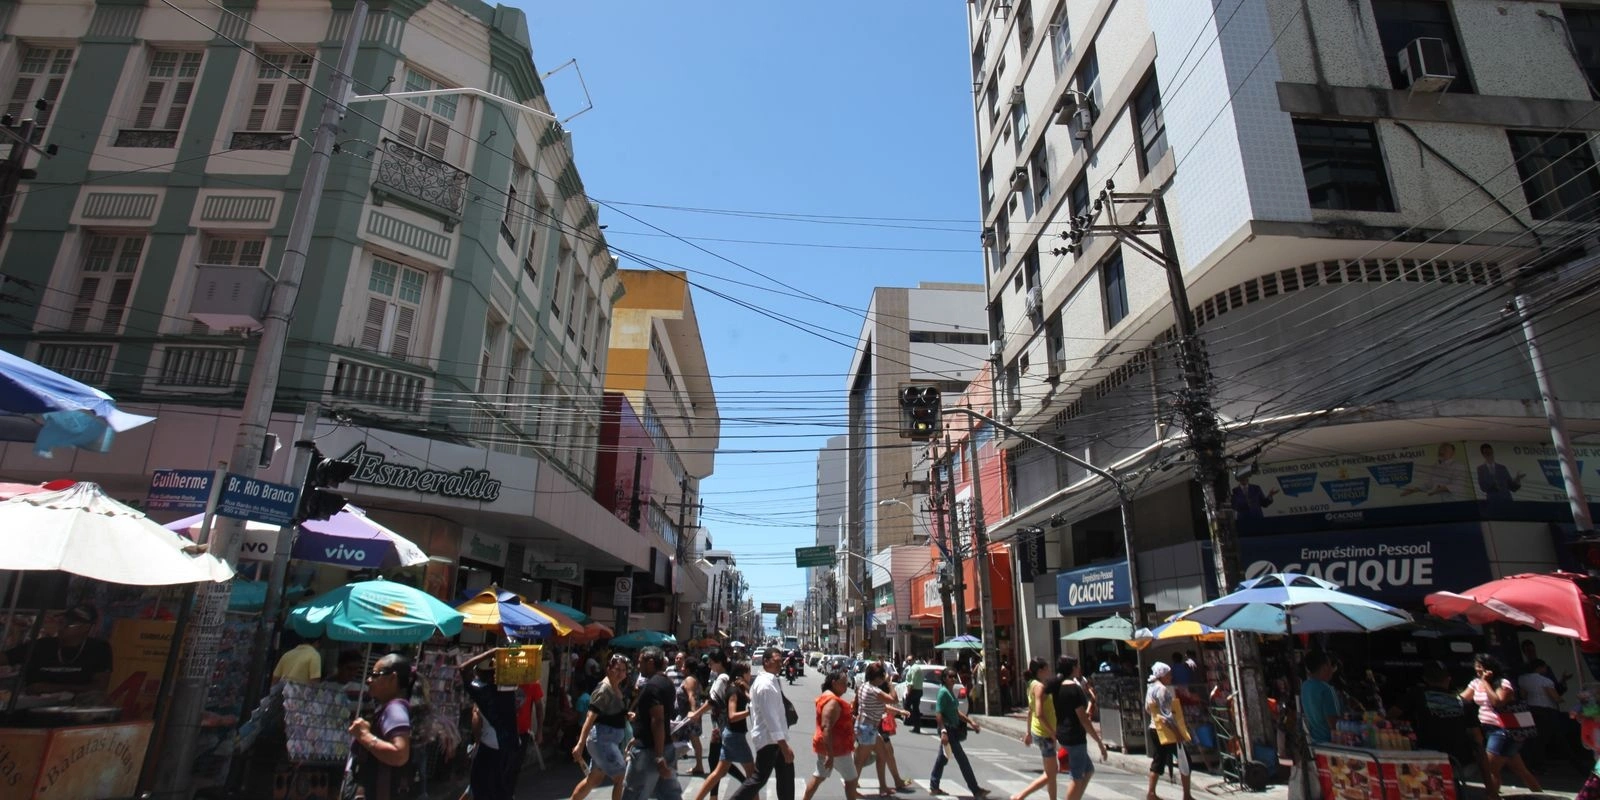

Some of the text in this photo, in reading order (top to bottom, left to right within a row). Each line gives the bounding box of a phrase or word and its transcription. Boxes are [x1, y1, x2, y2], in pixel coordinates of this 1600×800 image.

[1301, 463, 1317, 472] QUE
[1319, 459, 1339, 468] VOCÊ
[1399, 450, 1425, 460] AQUI!
[1523, 447, 1558, 456] DINHEI
[152, 472, 208, 489] Guilherme
[349, 452, 502, 501] Esmeralda
[228, 477, 295, 504] Br. Rio Branco
[1332, 511, 1362, 520] CACIQUE
[241, 542, 268, 553] ivo
[325, 544, 366, 561] vivo
[1301, 541, 1431, 562] Empréstimo Pessoal
[1077, 582, 1114, 604] CACIQUE
[47, 737, 105, 786] Batatas
